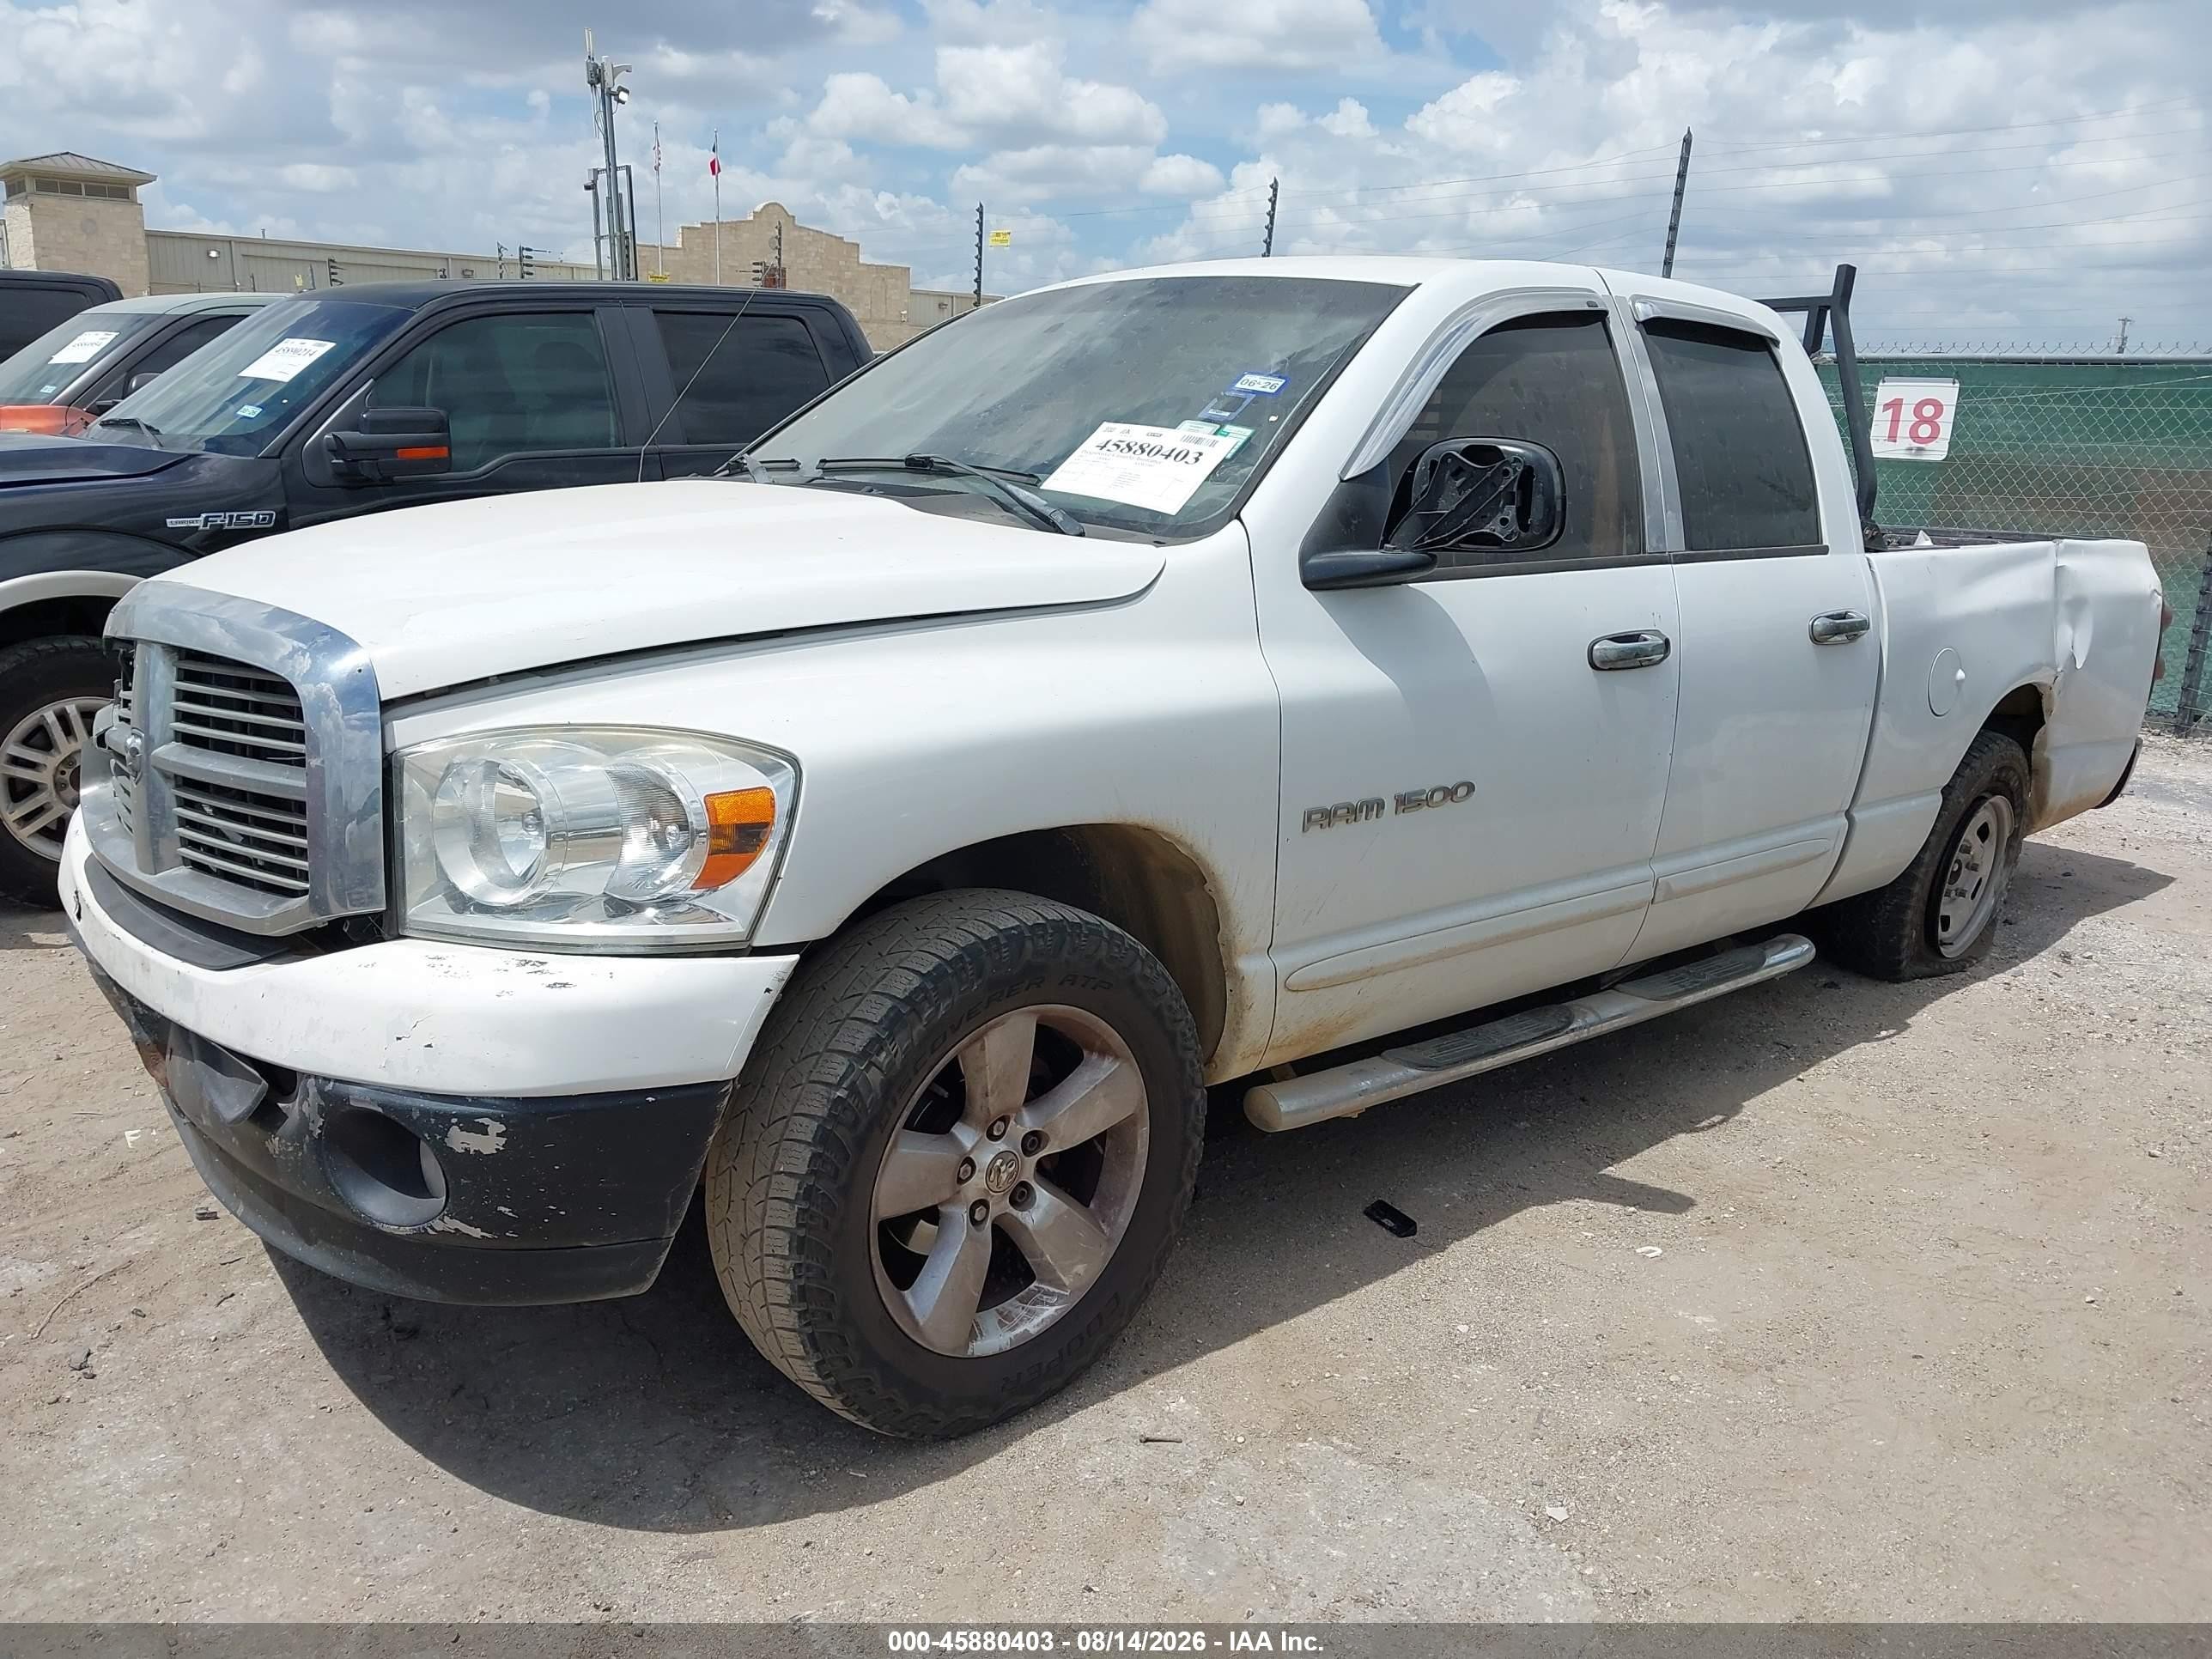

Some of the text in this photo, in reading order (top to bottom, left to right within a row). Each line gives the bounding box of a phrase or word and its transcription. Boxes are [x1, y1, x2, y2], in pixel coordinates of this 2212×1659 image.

[1882, 398, 1944, 445] 18
[1095, 439, 1204, 465] 45880403
[198, 511, 276, 530] F-150
[1302, 781, 1476, 832] RAM 1500
[1057, 973, 1114, 990] ATP
[1000, 1291, 1125, 1394] COOPER
